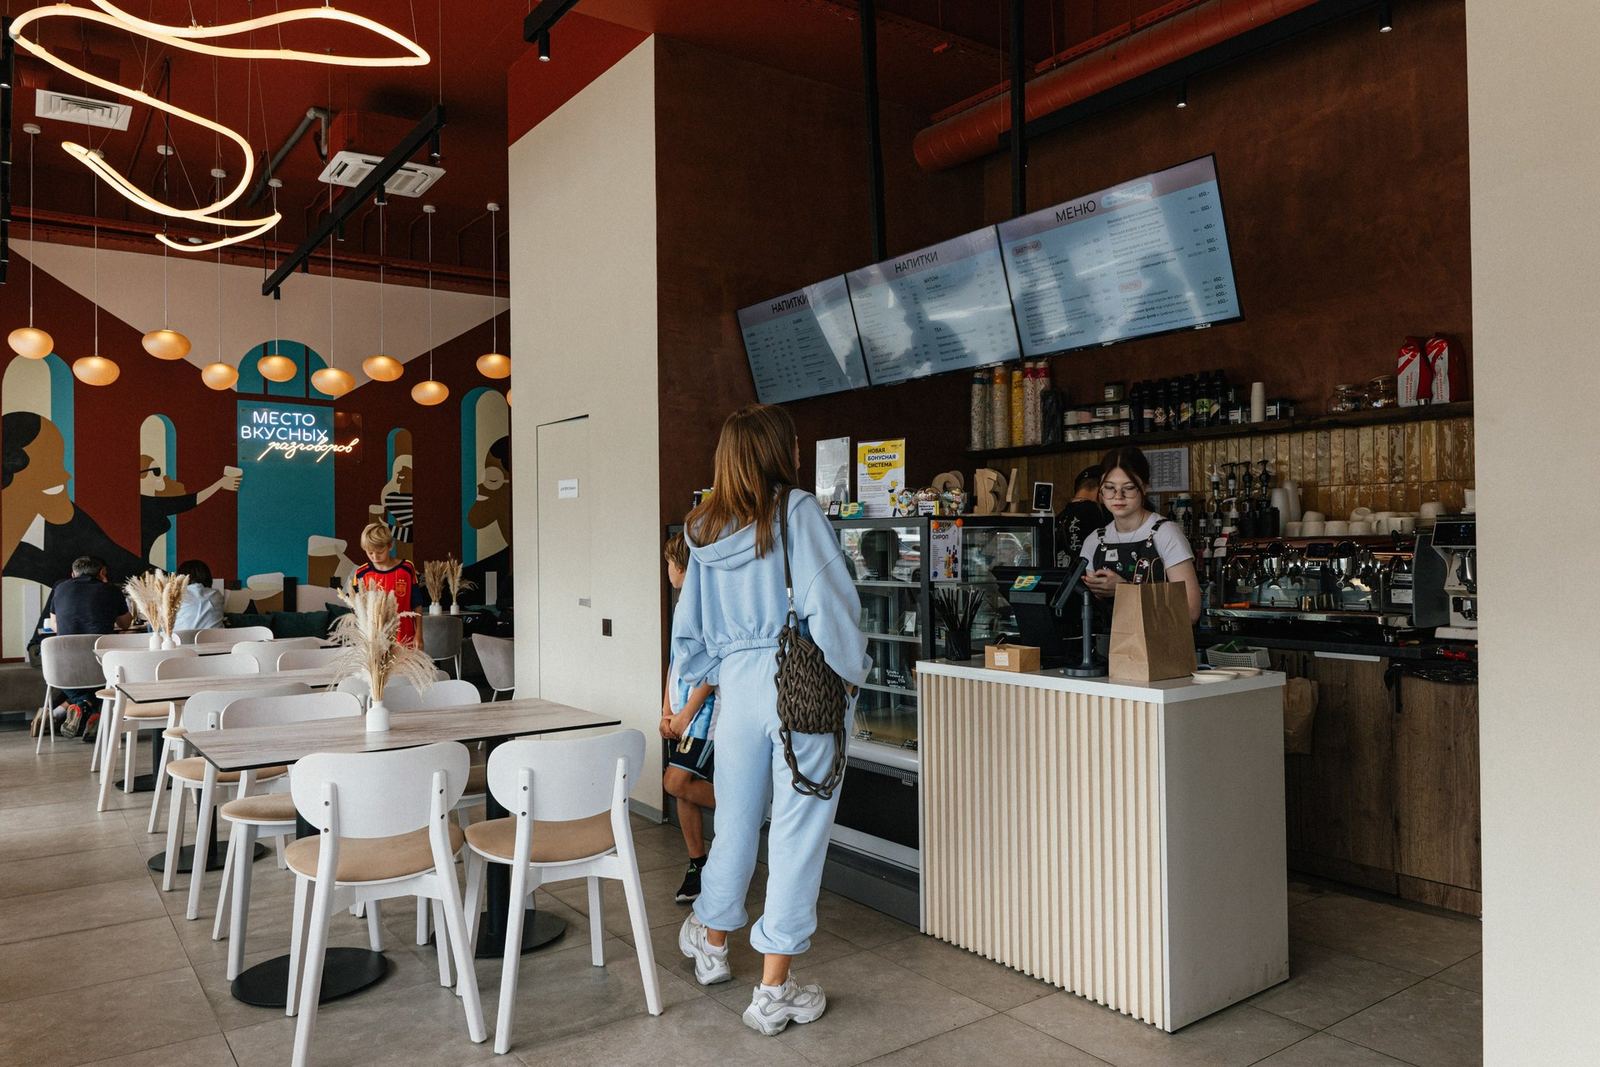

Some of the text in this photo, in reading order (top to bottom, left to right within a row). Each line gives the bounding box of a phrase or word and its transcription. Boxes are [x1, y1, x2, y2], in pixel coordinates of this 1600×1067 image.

[1055, 200, 1096, 222] МЕНЮ
[895, 250, 938, 274] НАПИТКИ
[771, 294, 809, 313] НАПИТКИ
[252, 411, 316, 427] МЕСТО
[240, 426, 328, 442] ВКУСНЫХ
[256, 437, 360, 463] разговоров
[867, 454, 897, 462] БОНУСНАЯ
